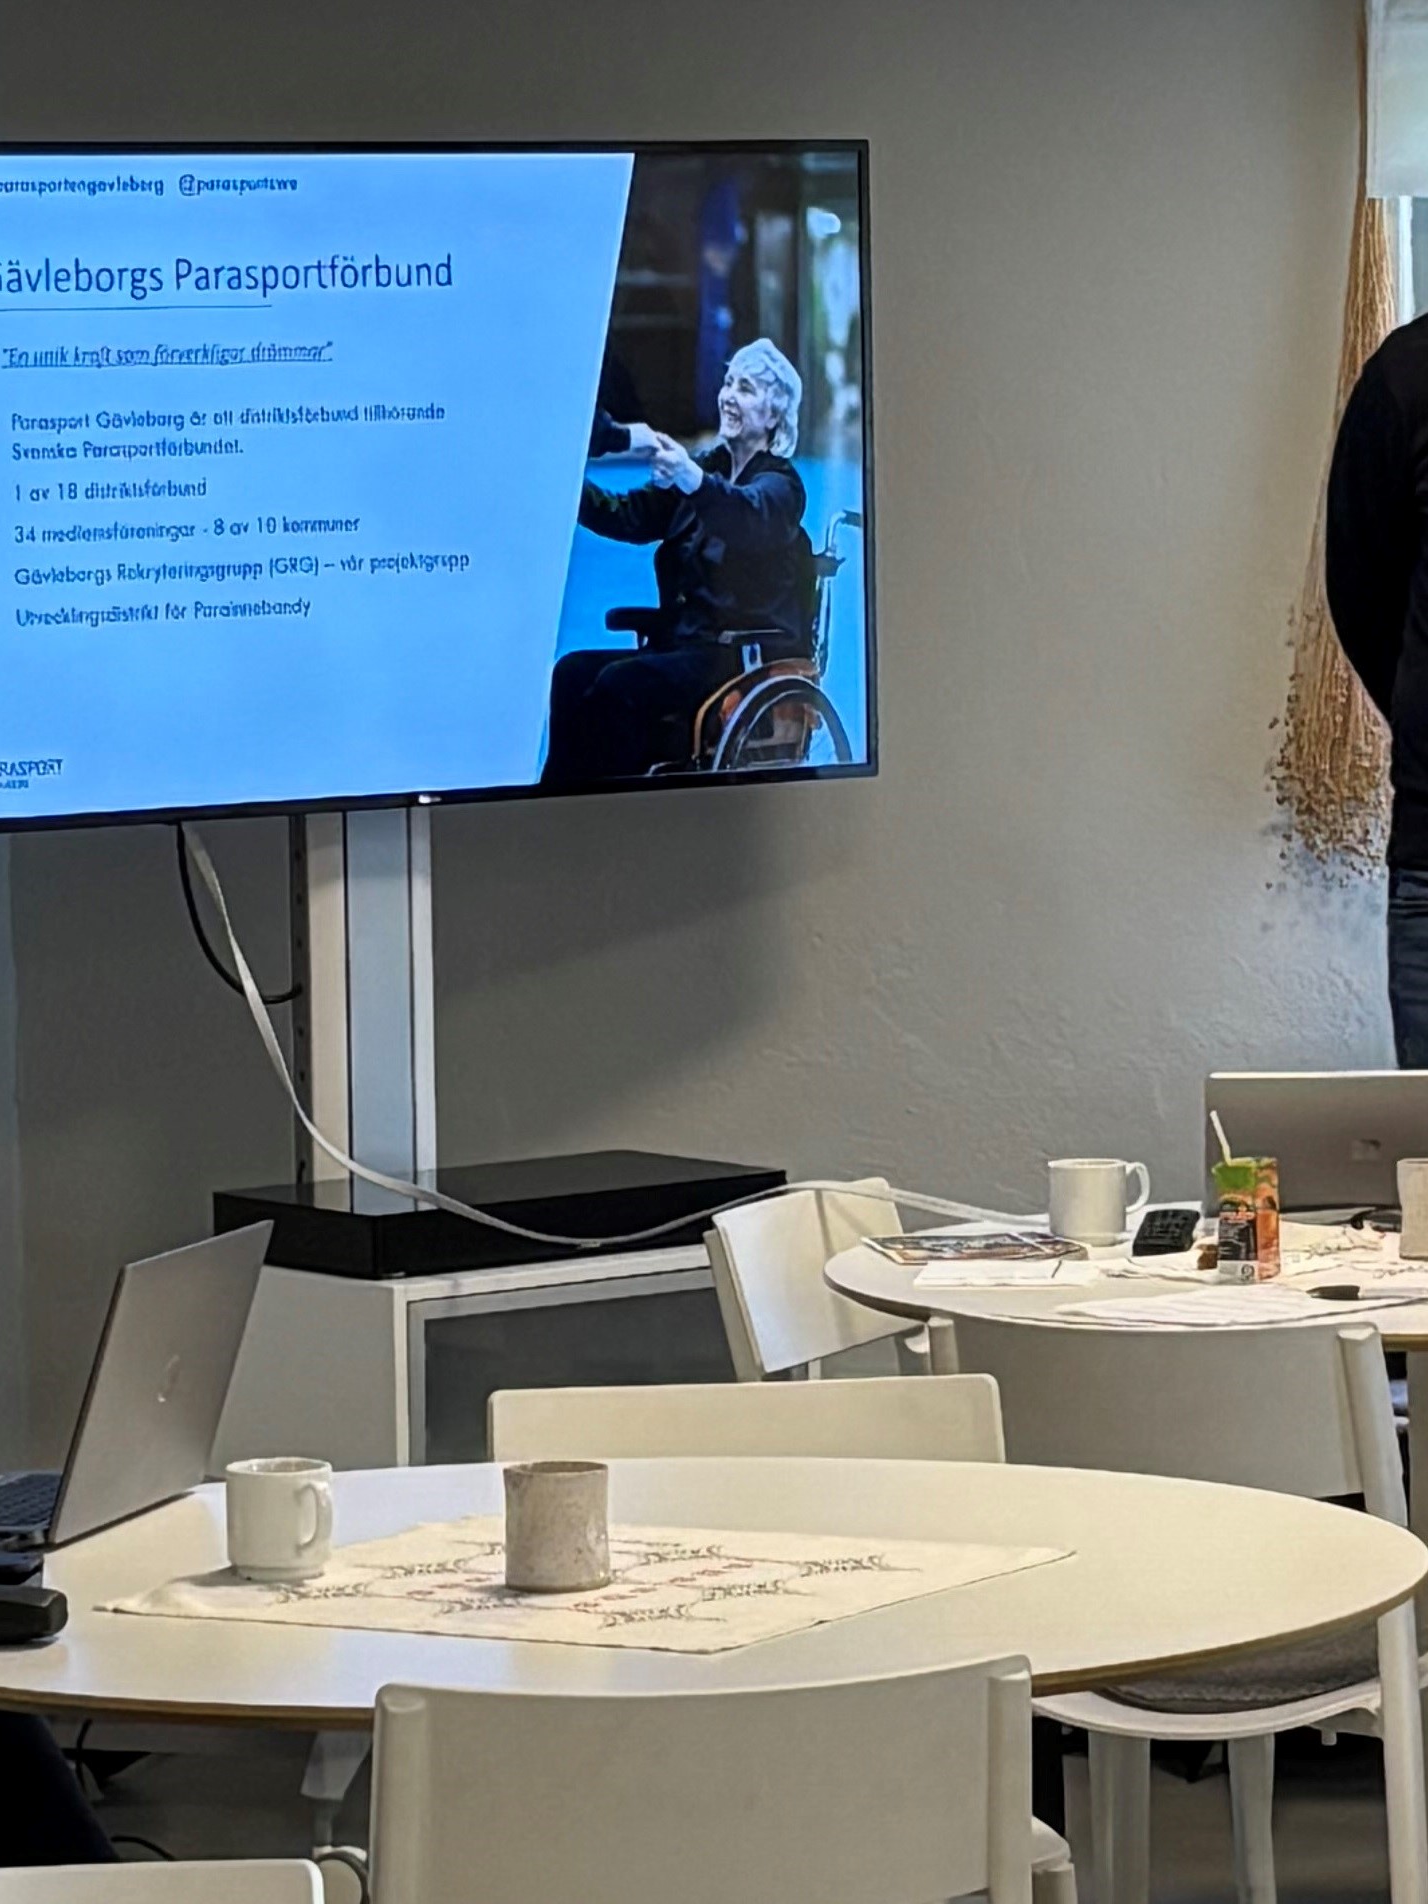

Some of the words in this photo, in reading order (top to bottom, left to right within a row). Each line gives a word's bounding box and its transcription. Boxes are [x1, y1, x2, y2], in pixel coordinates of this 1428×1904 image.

[175, 253, 452, 298] Parasportförbund
[34, 346, 68, 367] unik
[73, 344, 111, 368] kraft
[116, 348, 149, 365] som
[11, 412, 90, 434] Parasport
[96, 410, 184, 431] Gävleborg
[190, 411, 207, 426] är
[213, 409, 233, 426] ett
[240, 405, 359, 425] distriktsförbund
[364, 402, 445, 423] tillhörande
[12, 442, 77, 461] Svenska
[82, 438, 244, 462] Parasportförbundet.
[15, 483, 21, 502] 1
[29, 486, 50, 502] av
[58, 482, 78, 500] 18
[84, 477, 207, 501] distriktsförbund
[14, 524, 36, 543] 34
[42, 520, 195, 543] medlemsföreningar
[213, 517, 225, 536] 8
[230, 520, 249, 536] av
[257, 516, 277, 534] 10
[282, 515, 360, 533] kommuner
[14, 565, 112, 586] Gävleborgs
[118, 562, 263, 583] Rekryteringsgrupp
[269, 555, 319, 578] (GRG)
[340, 554, 364, 572] vår
[370, 551, 470, 575] projektgrupp
[165, 602, 186, 621] för
[194, 597, 311, 620] Parainnebandy
